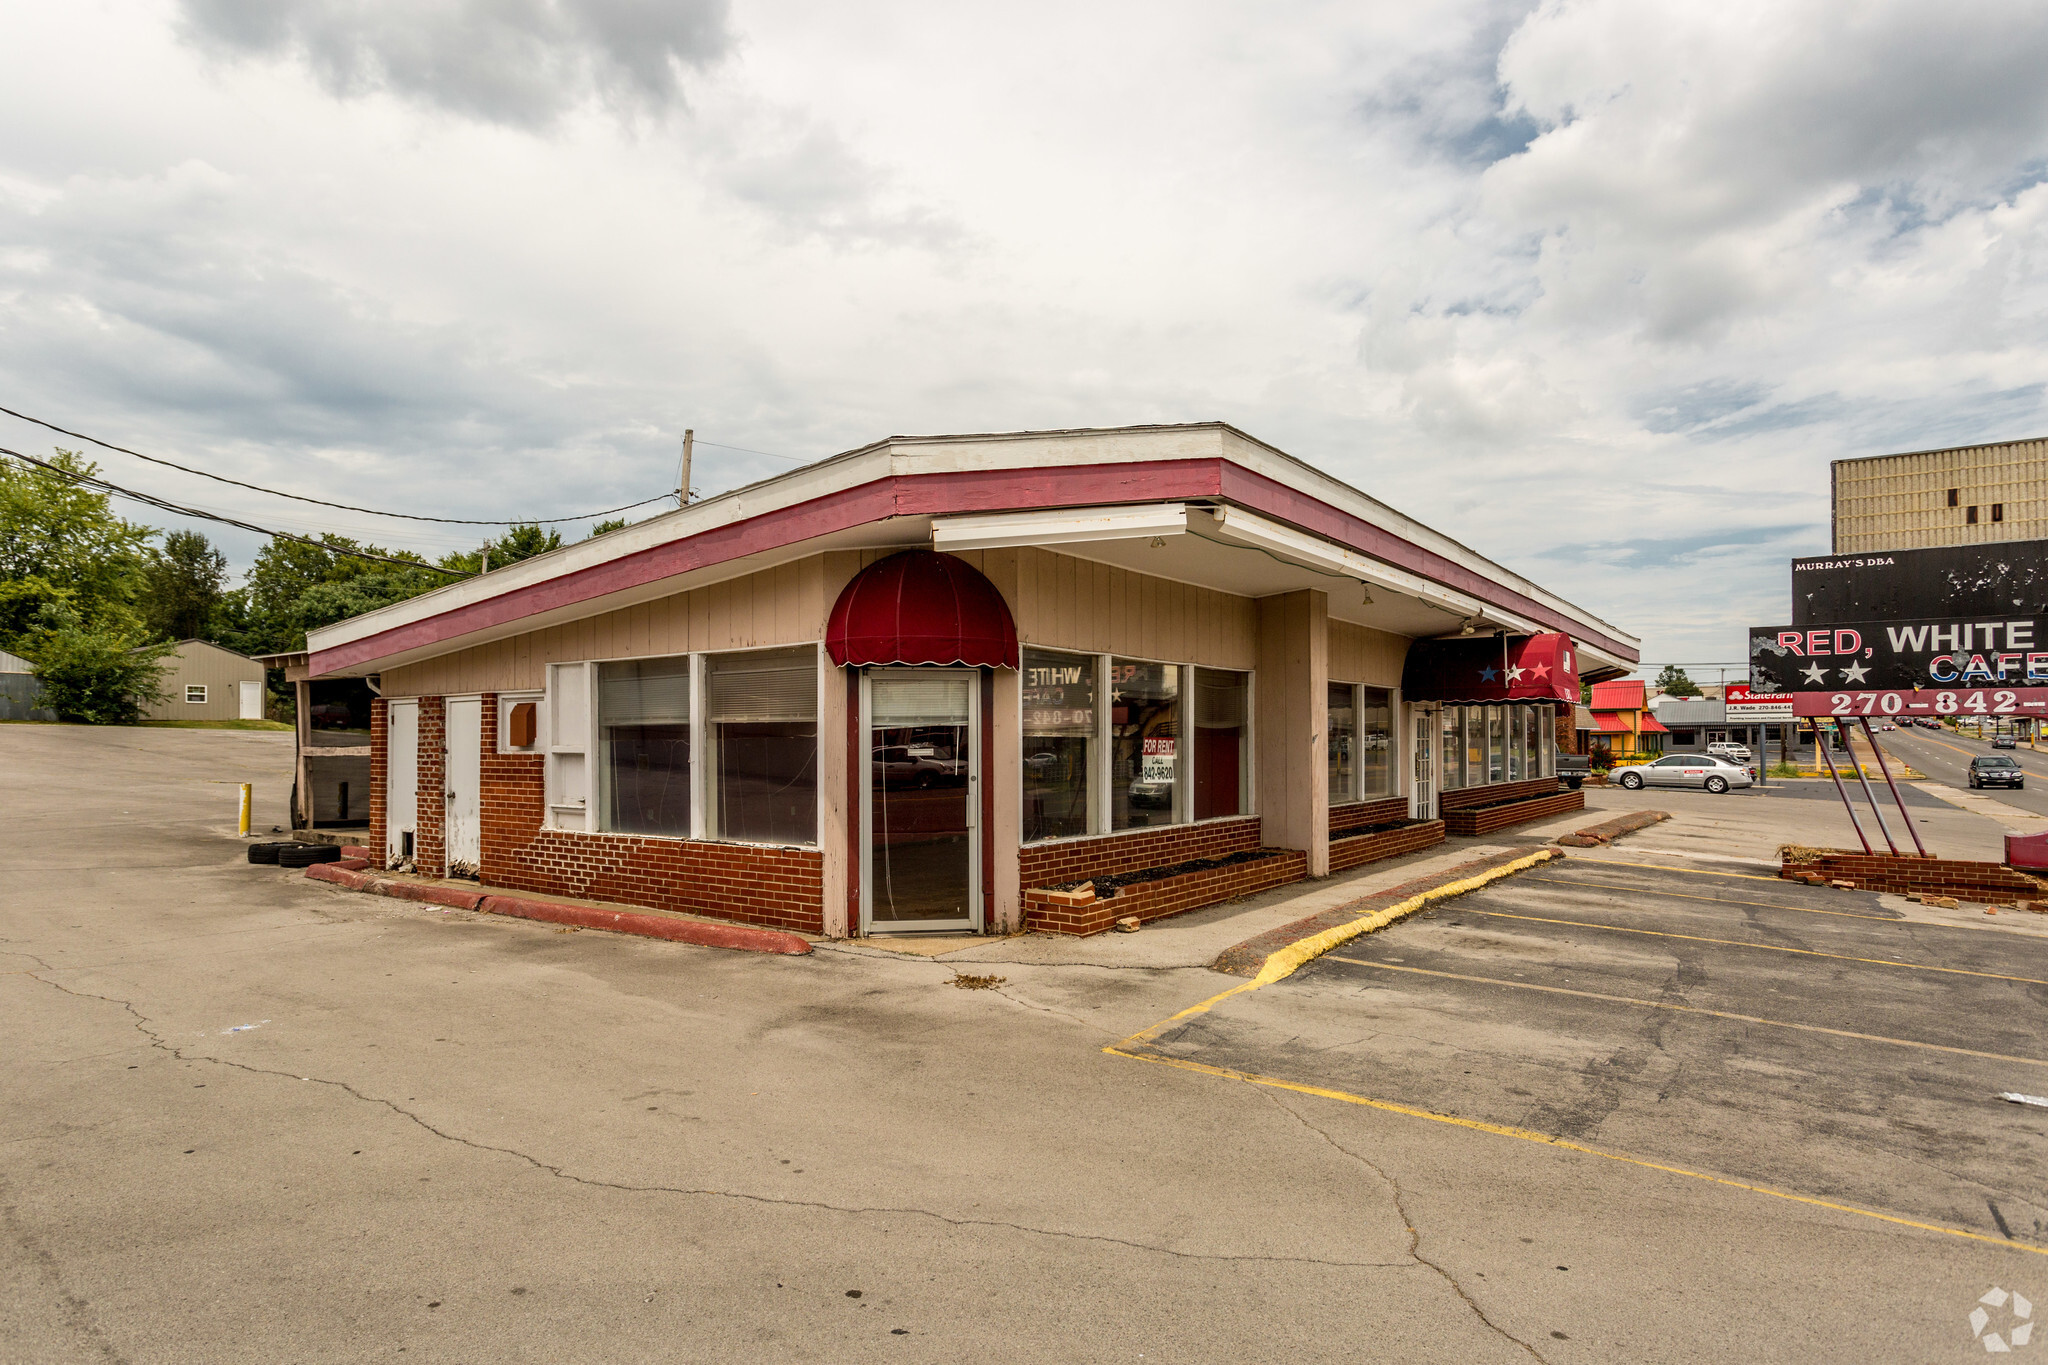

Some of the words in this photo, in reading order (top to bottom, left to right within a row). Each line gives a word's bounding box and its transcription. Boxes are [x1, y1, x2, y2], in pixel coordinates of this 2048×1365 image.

[1795, 559, 1864, 571] MURRAY'S
[1867, 557, 1895, 567] DBA
[1777, 628, 1873, 659] RED,
[1886, 621, 2035, 653] WHITE
[1929, 652, 2048, 682] CAFE
[1144, 739, 1157, 753] FOR
[1157, 739, 1174, 753] RENT
[1144, 766, 1173, 780] 842-9620
